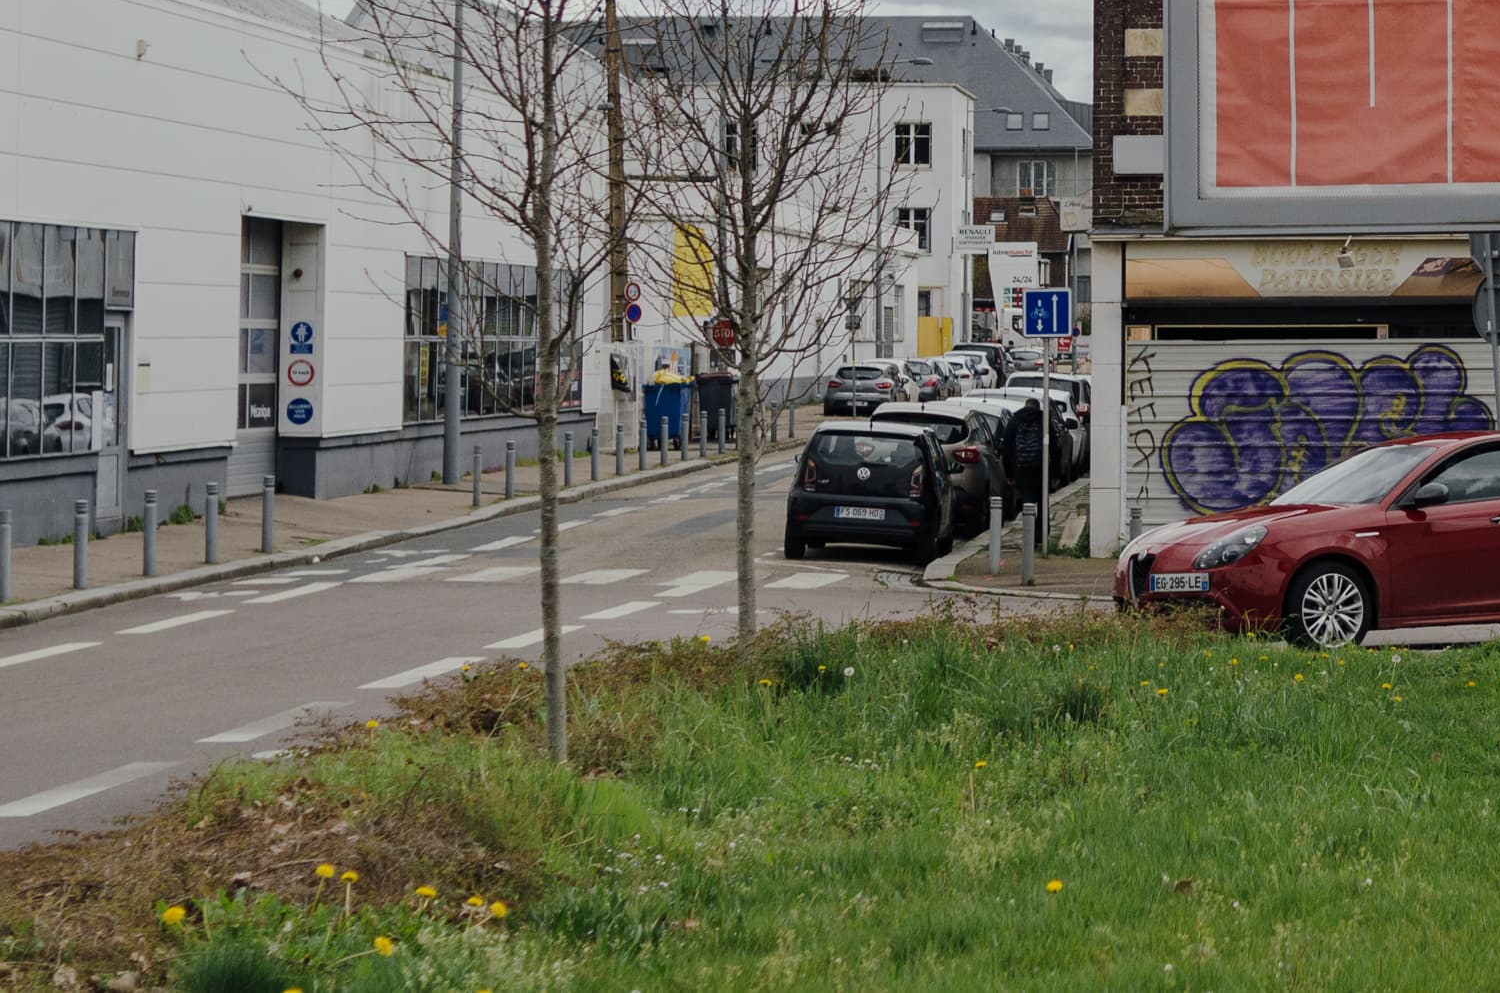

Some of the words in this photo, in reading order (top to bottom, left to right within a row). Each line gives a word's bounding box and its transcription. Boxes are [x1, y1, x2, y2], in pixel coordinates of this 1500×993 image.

[959, 228, 992, 236] RENAULT
[1012, 276, 1033, 284] 24/24
[1258, 267, 1397, 294] PATISSIER
